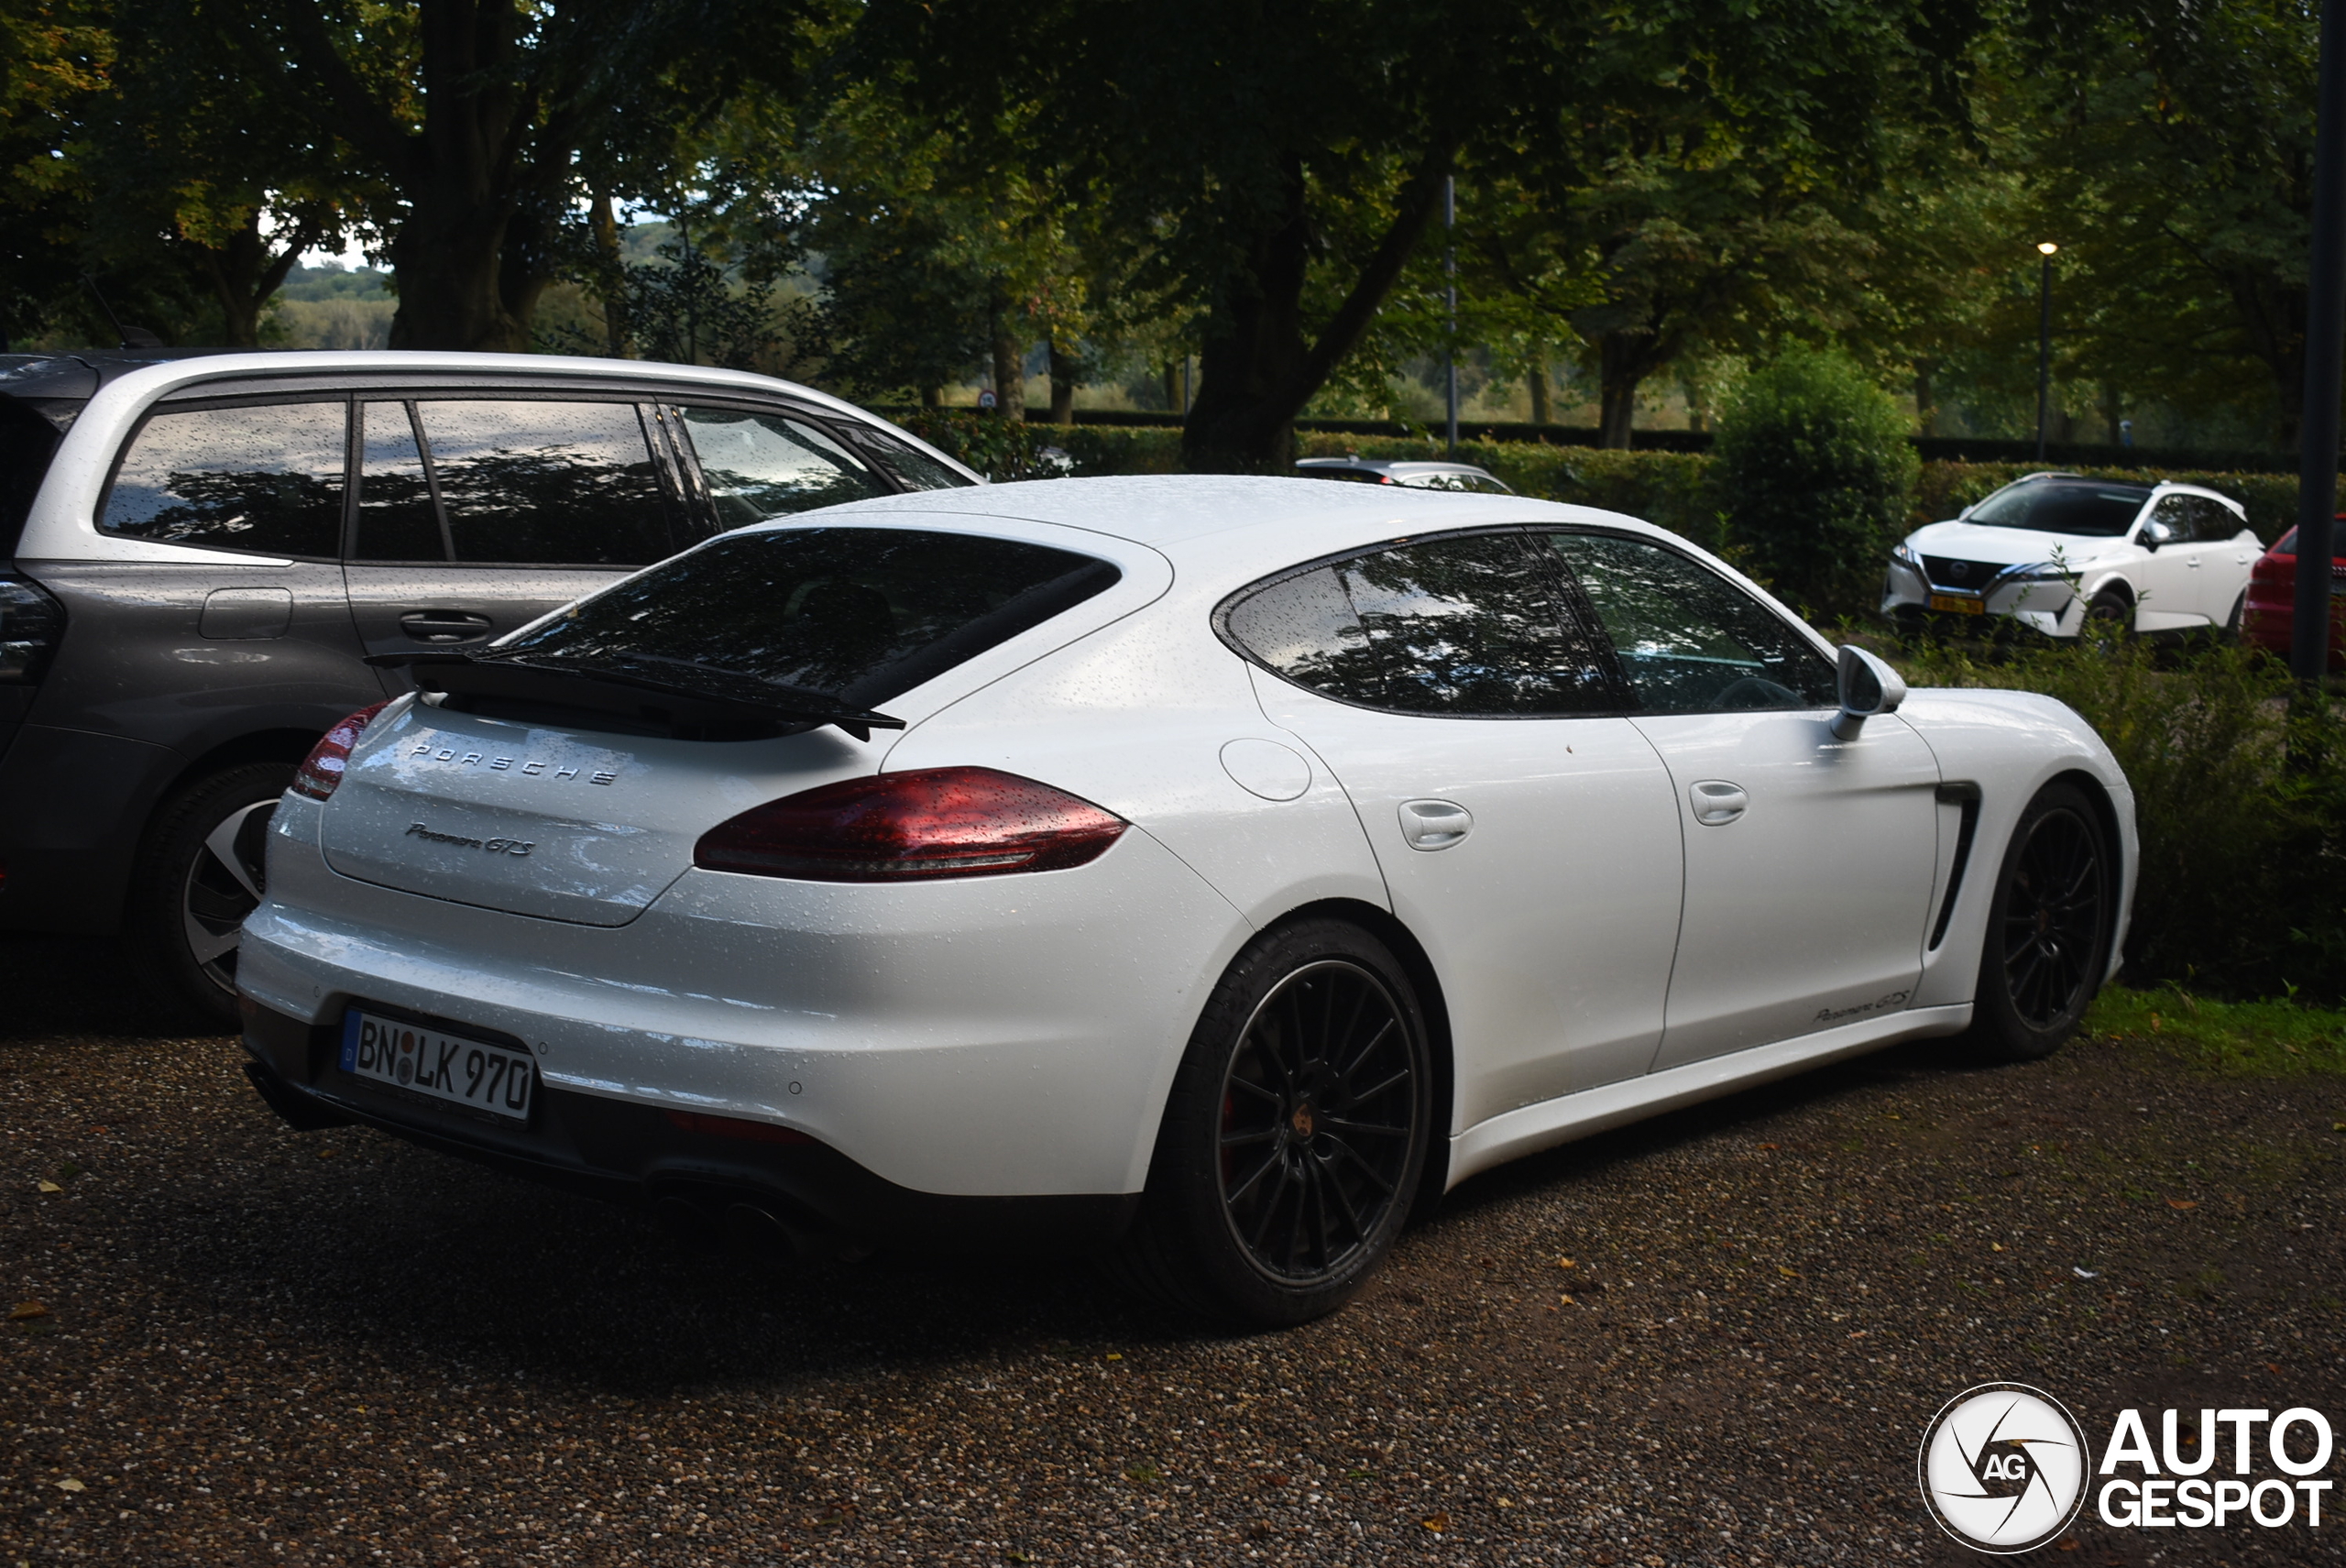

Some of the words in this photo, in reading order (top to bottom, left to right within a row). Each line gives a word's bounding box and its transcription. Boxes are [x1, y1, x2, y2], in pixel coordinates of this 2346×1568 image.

[411, 744, 619, 786] PORSCHE
[405, 821, 483, 849] Panamera
[485, 836, 536, 856] GTS
[357, 1020, 399, 1077] BN
[415, 1035, 460, 1093] LK
[465, 1049, 531, 1111] 970
